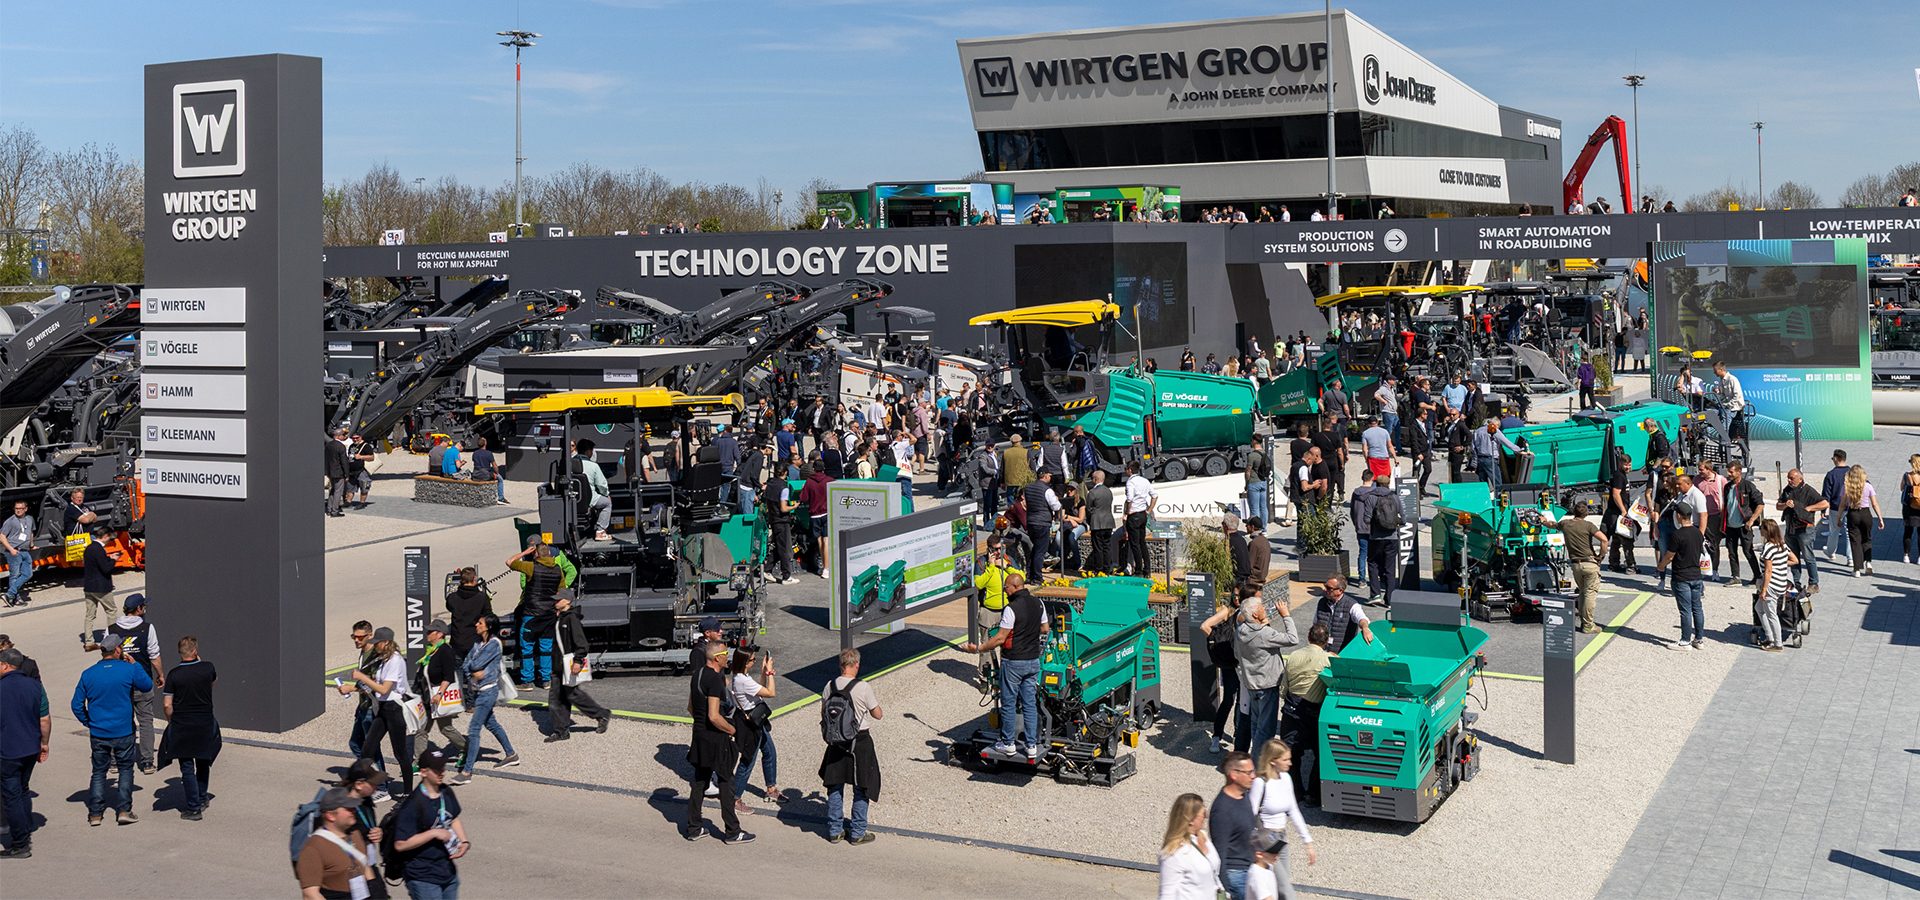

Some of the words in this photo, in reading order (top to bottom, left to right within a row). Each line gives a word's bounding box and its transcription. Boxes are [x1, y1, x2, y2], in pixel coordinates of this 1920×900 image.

[1024, 51, 1190, 88] WIRTGEN
[1197, 42, 1329, 78] GROUP
[1169, 91, 1179, 103] A
[1182, 90, 1219, 102] JOHN
[1223, 86, 1265, 100] DEERE
[1269, 83, 1338, 97] COMPANY
[1383, 71, 1408, 98] JOHN
[1408, 77, 1436, 105] DEERE
[1440, 169, 1456, 184] CLOSE
[1456, 171, 1463, 184] TO
[1464, 173, 1475, 186] OUR
[1475, 173, 1501, 188] CUSTOMERS
[162, 188, 256, 215] WIRTGEN
[172, 216, 246, 241] GROUP
[1479, 227, 1521, 238] SMART
[1524, 225, 1611, 237] AUTOMATION
[1298, 230, 1374, 241] PRODUCTION
[1863, 233, 1891, 243] MIX
[1264, 243, 1307, 253] SYSTEM
[1310, 242, 1375, 252] SOLUTIONS
[1479, 240, 1492, 250] IN
[1496, 238, 1592, 250] ROADBUILDING
[417, 251, 457, 260] RECYCLING
[635, 246, 847, 277] TECHNOLOGY
[855, 244, 949, 274] ZONE
[417, 260, 432, 269] FOR
[433, 260, 448, 268] HOT
[450, 260, 464, 268] MIX
[466, 259, 498, 268] ASPHALT
[161, 300, 206, 311] WIRTGEN
[34, 321, 60, 343] WIRTGEN
[161, 341, 198, 354] VÖGELE
[161, 386, 193, 397] HAMM
[1175, 392, 1208, 402] VÖGELE
[585, 397, 618, 405] VÖGELE
[161, 428, 216, 441] KLEEMANN
[161, 471, 241, 486] BENNINGHOVEN
[1157, 504, 1185, 514] ON
[1400, 522, 1414, 566] NEW
[407, 597, 424, 649] NEW
[1121, 646, 1134, 657] VÖGELE
[443, 689, 462, 701] PERI
[1350, 715, 1384, 727] VÖGELE
